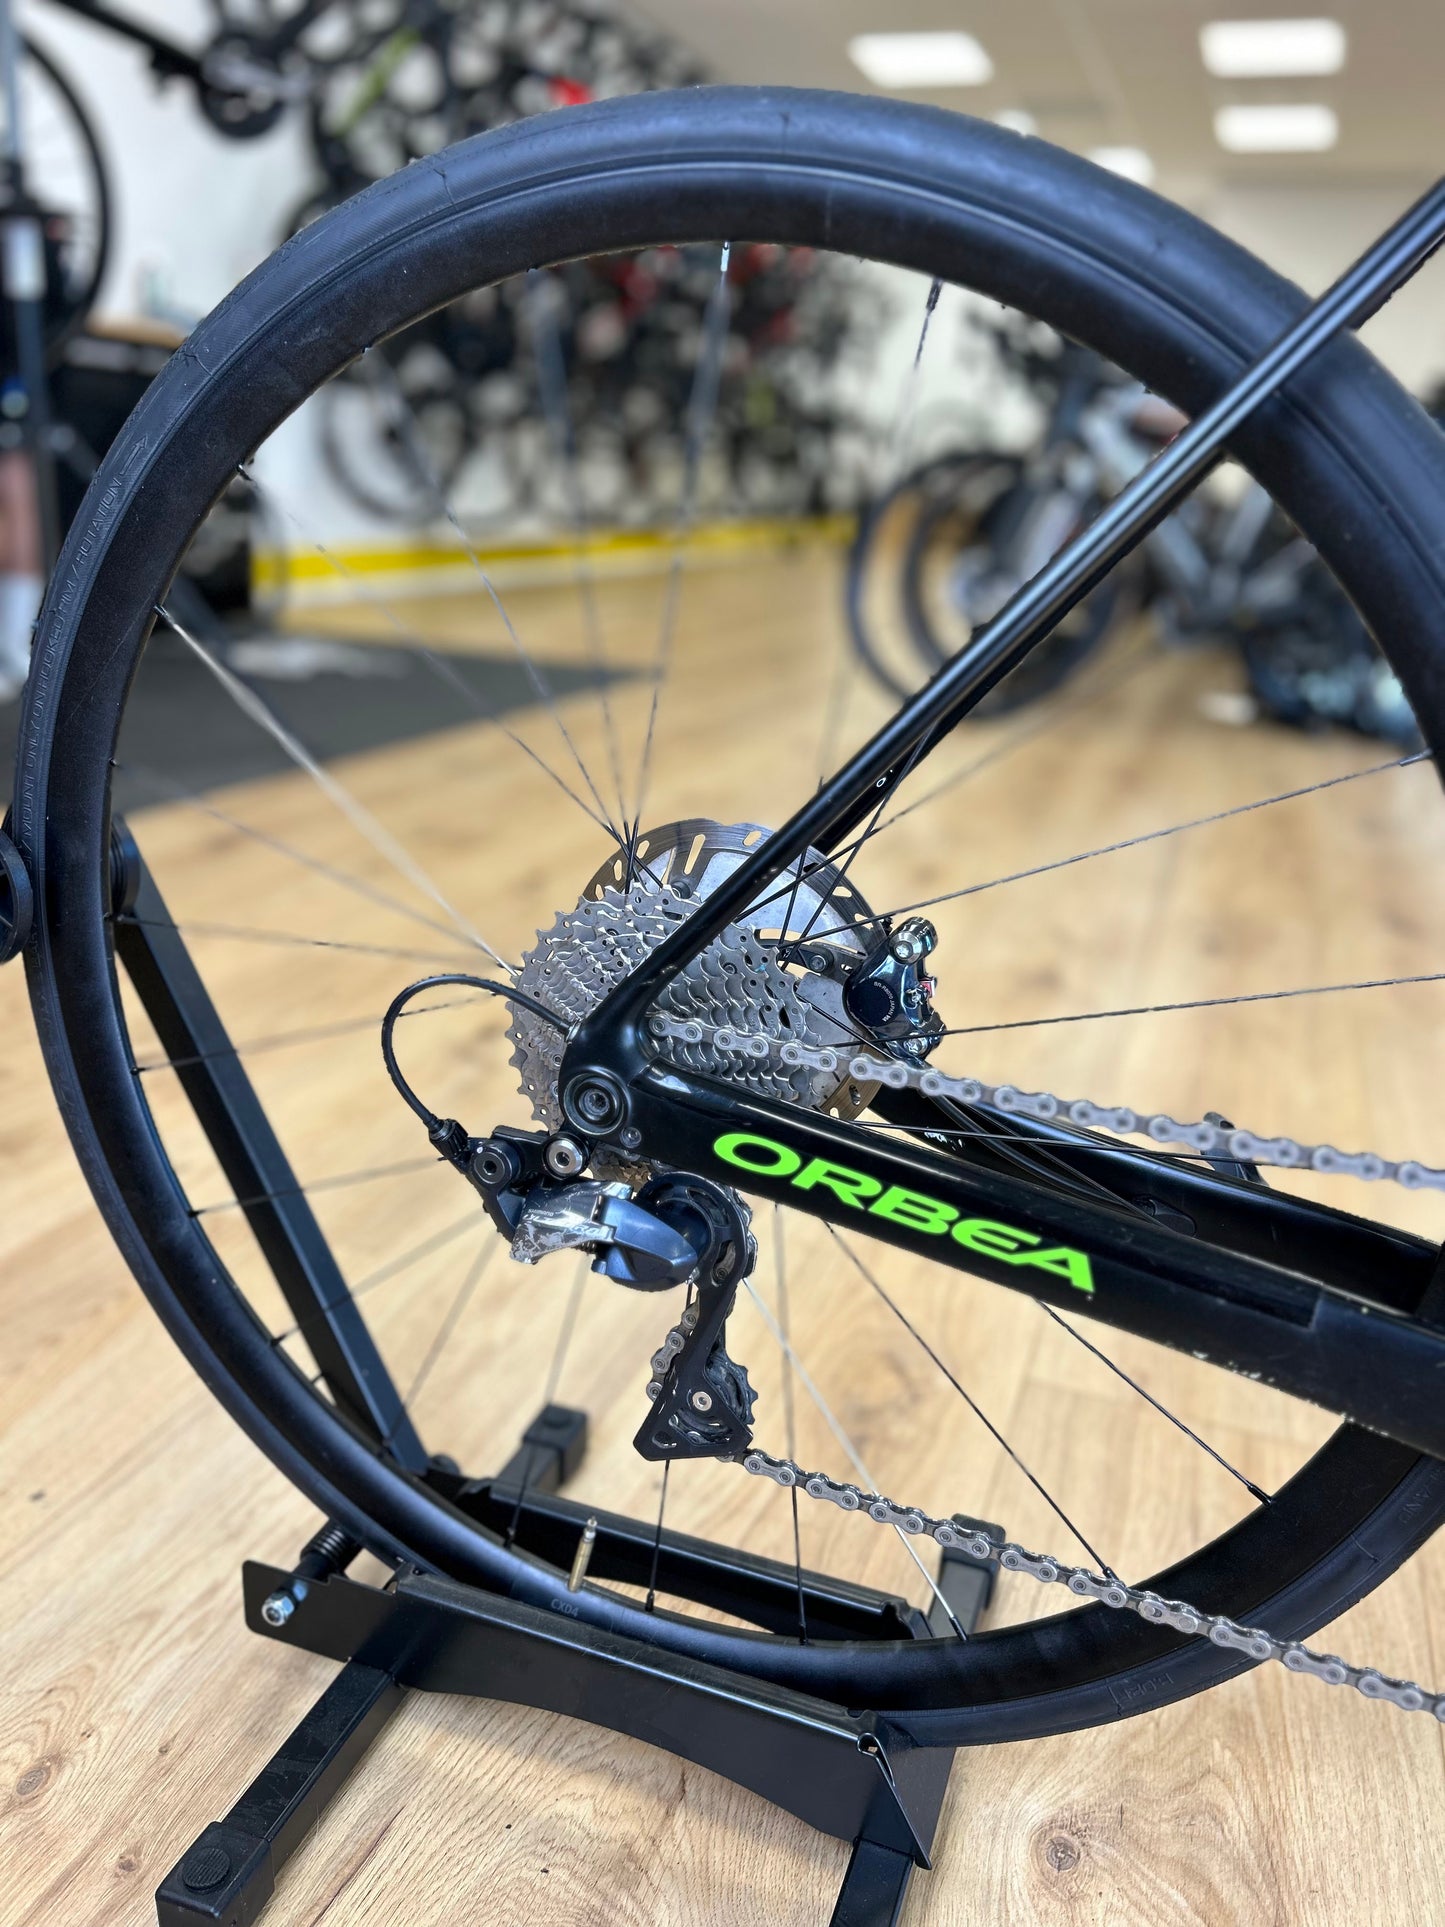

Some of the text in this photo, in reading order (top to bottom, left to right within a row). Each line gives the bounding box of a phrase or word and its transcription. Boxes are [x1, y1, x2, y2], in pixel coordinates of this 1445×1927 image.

[76, 476, 122, 565] ROTATION
[58, 579, 76, 614] RIM
[39, 615, 66, 689] HOOKED
[34, 690, 46, 720] ON
[26, 720, 41, 768] ONLY
[22, 777, 35, 837] MOUNT
[888, 999, 896, 1016] JAPAN
[713, 1133, 1094, 1292] ORBEA
